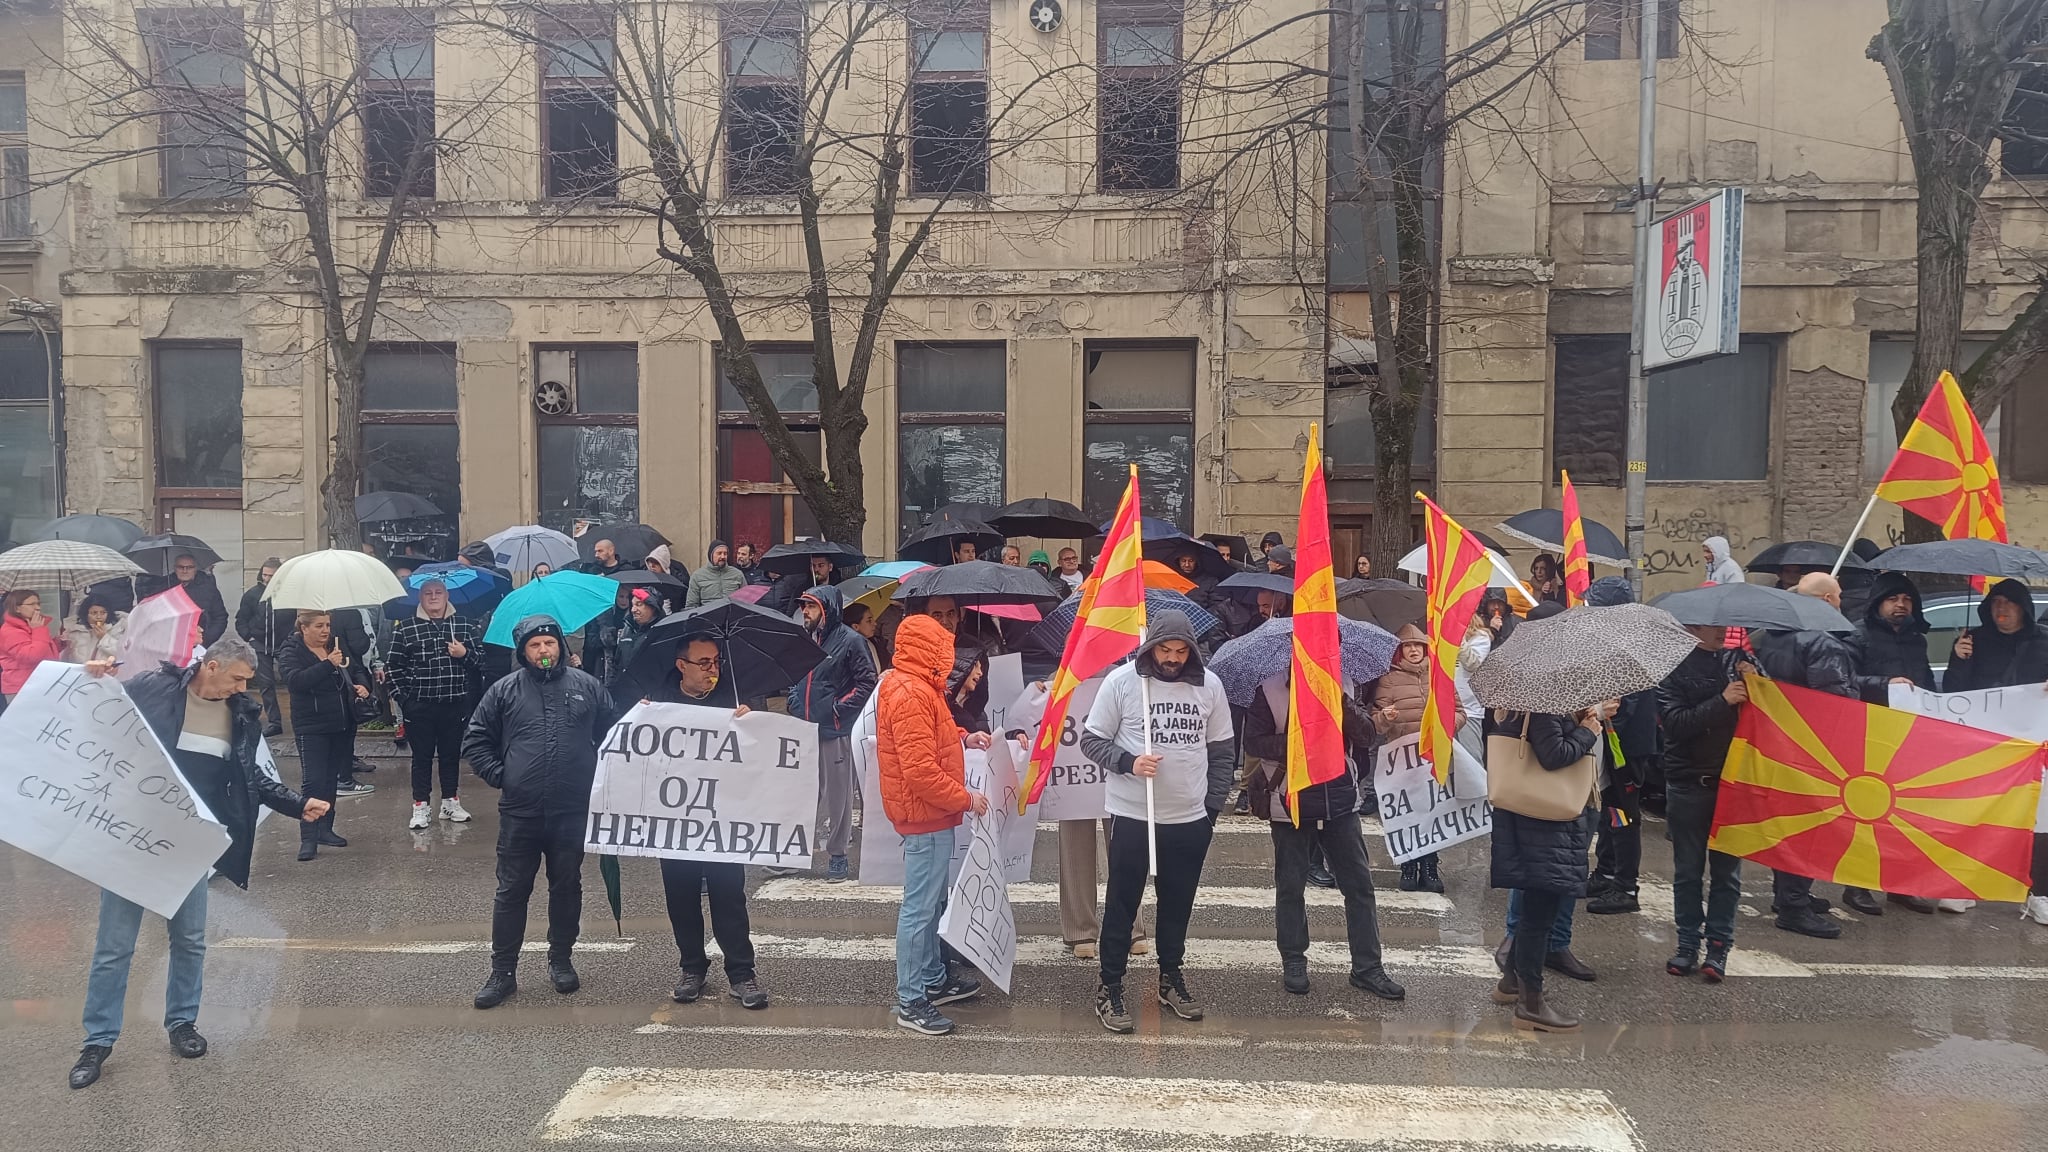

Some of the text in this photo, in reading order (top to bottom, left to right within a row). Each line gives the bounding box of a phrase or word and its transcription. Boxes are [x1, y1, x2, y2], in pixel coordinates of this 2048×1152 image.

[44, 667, 102, 708] НЕ
[1921, 689, 2003, 715] СТОП
[1149, 702, 1200, 716] УПРАВА
[36, 717, 72, 750] НЕ
[77, 741, 135, 779] СМЕ
[600, 721, 800, 769] ДОСТА Е
[74, 772, 112, 802] ЗА
[659, 776, 719, 818] ОД
[1381, 789, 1413, 820] ЗА
[587, 811, 811, 863] НЕПРАВДА
[1387, 799, 1493, 858] ПЉАЧКА
